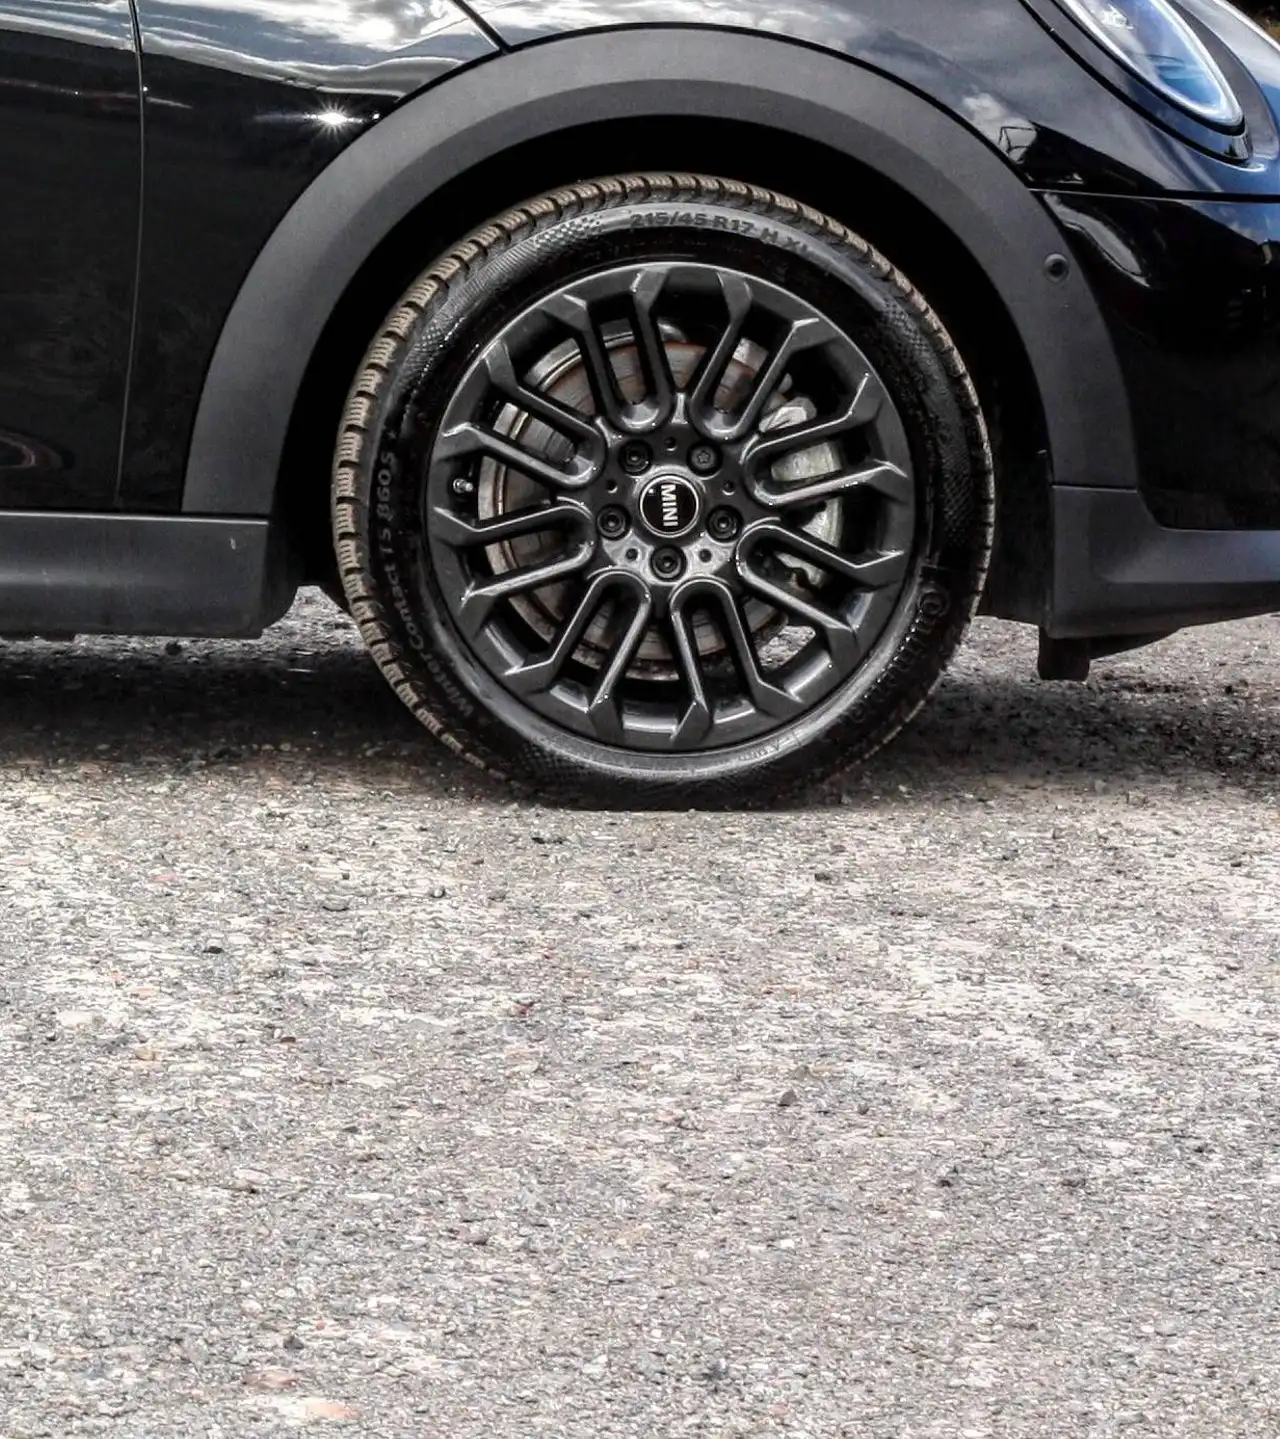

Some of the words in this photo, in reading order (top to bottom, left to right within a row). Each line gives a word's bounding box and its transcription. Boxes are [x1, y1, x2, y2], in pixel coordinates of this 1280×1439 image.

[630, 211, 709, 228] 215/45
[713, 215, 753, 236] R17
[661, 484, 679, 527] MINI
